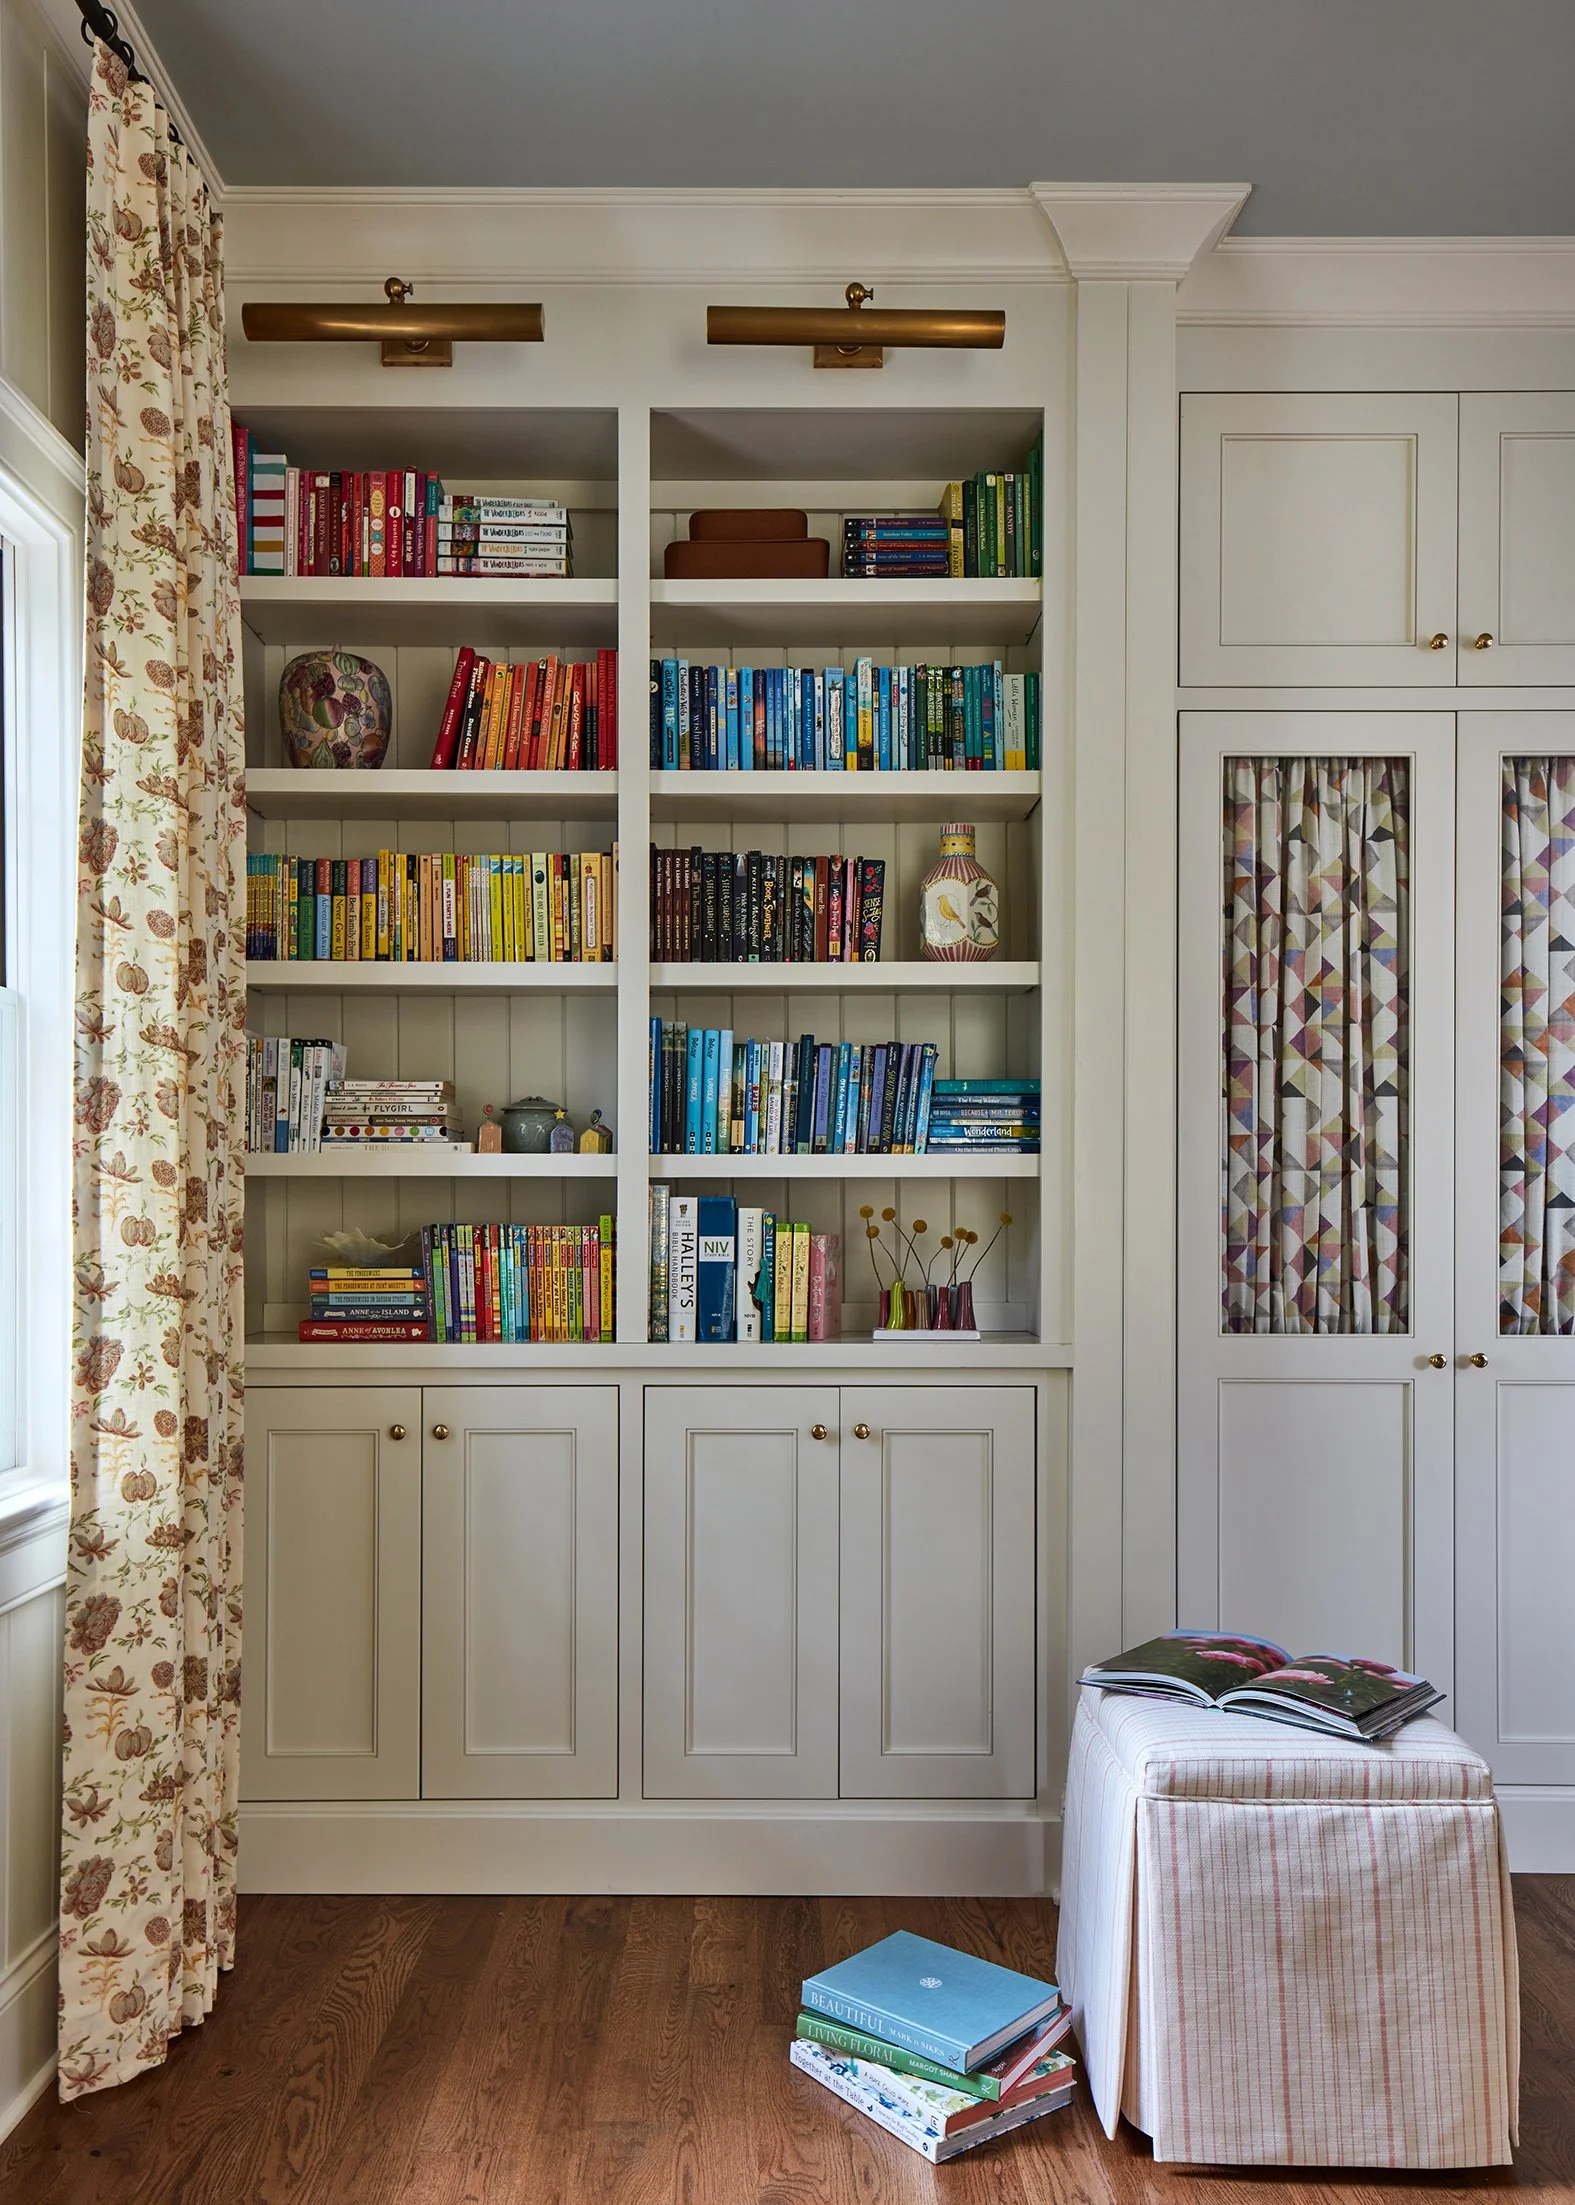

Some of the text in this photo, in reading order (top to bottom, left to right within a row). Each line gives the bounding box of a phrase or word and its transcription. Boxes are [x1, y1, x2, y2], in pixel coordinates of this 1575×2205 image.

[391, 550, 398, 558] by
[451, 660, 466, 698] Trust First
[477, 661, 485, 683] Killers
[679, 667, 687, 701] Charlotte's
[467, 667, 478, 709] Flower Moon
[513, 692, 521, 705] Little
[511, 705, 519, 720] House
[522, 701, 532, 745] mockingbird
[1011, 698, 1019, 720] Women
[463, 718, 474, 758] David Grann
[488, 704, 499, 757] UNTEACHABLES
[572, 691, 581, 760] RESTART
[705, 879, 714, 899] STELLA
[722, 879, 730, 899] STELLA
[303, 900, 311, 930] Finding
[364, 902, 372, 922] Being
[763, 881, 773, 941] BOOK SCAVENGER
[817, 904, 825, 915] Boy
[335, 923, 343, 944] Grow
[348, 897, 357, 957] Best Family Ever
[365, 925, 373, 950] Baxters
[739, 914, 747, 940] Prejudice
[749, 905, 759, 948] Mockingbird
[333, 946, 343, 957] Up
[264, 1113, 269, 1122] MY
[882, 1069, 896, 1143] SHOUTING AT RAIN
[964, 1127, 1012, 1137] Wonderland
[704, 1241, 729, 1253] NIV
[746, 1237, 754, 1268] STORY
[671, 1232, 679, 1300] BIBLE HANDBOOK
[680, 1232, 694, 1308] HALLEY'S
[810, 1991, 885, 2032] BEAUTIFUL
[807, 2025, 960, 2081] LIVING FLORAL MARGOT SHAW
[889, 2028, 945, 2056] MARK SIKES
[794, 2053, 865, 2106] Together at the Table
